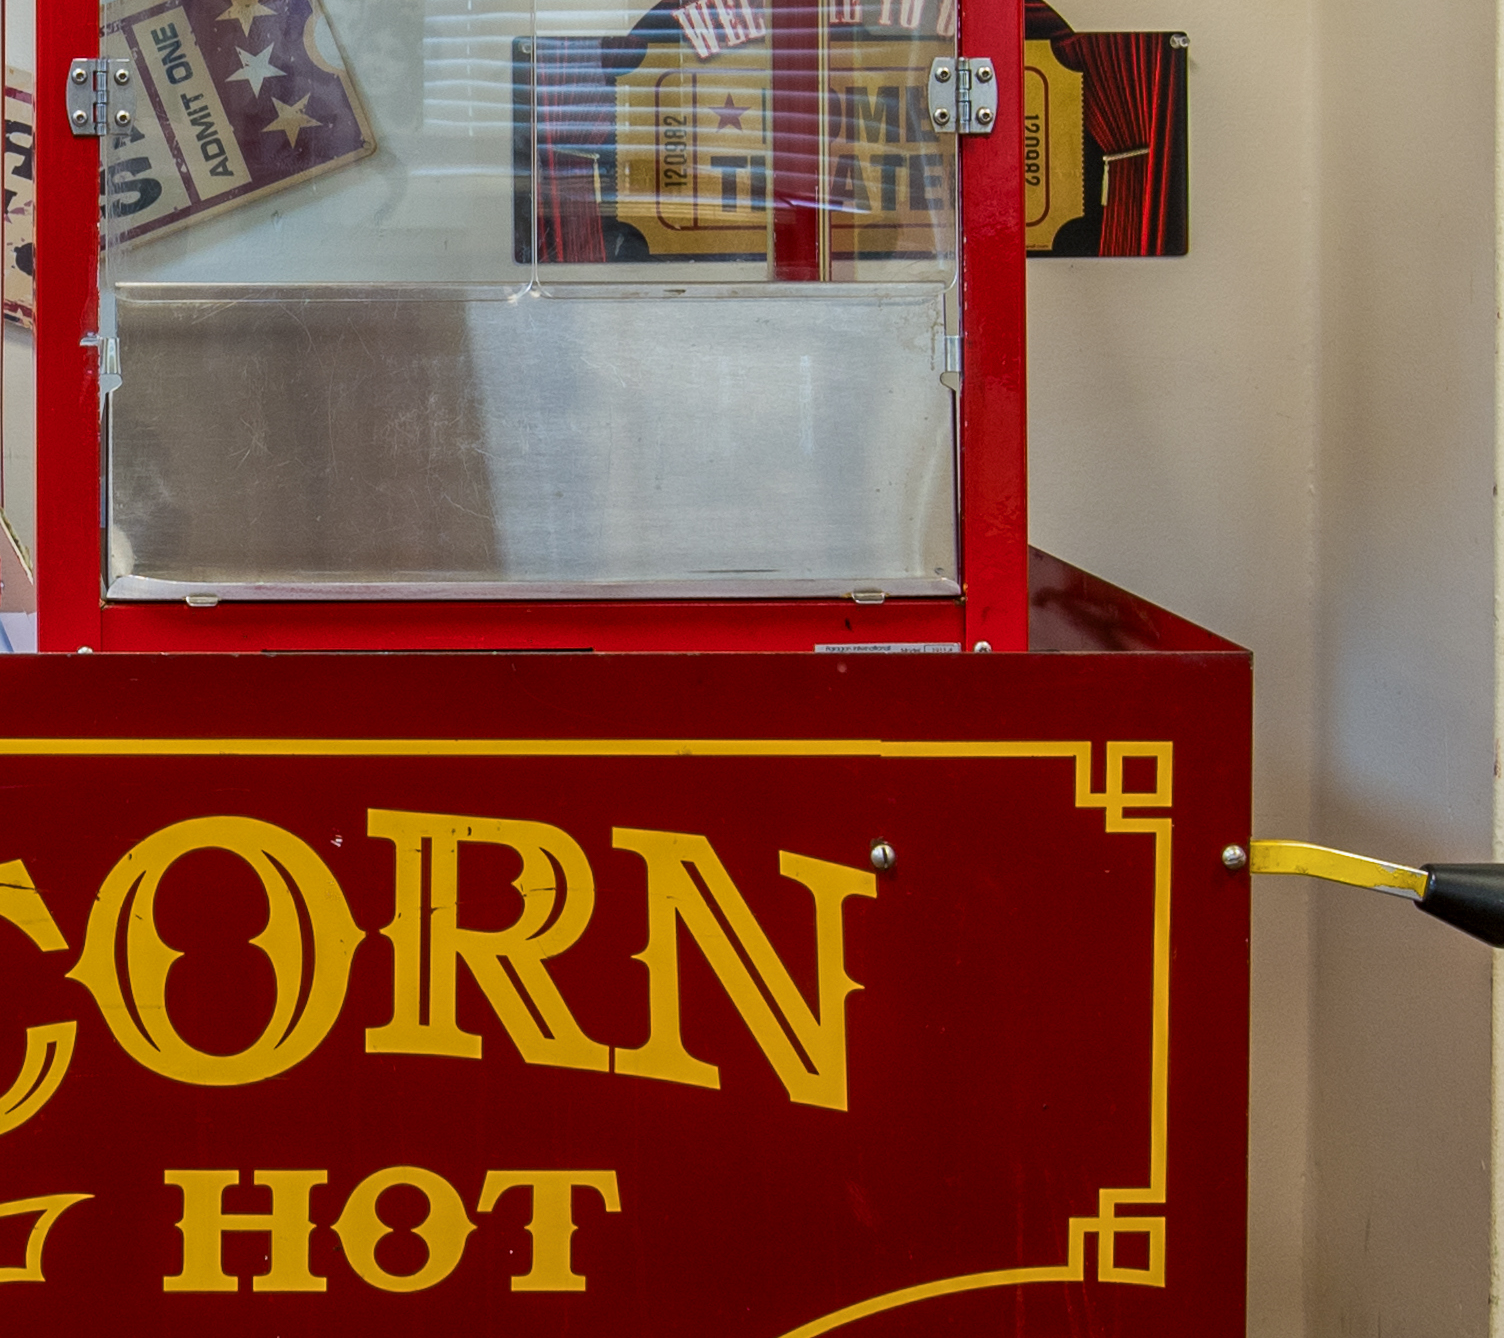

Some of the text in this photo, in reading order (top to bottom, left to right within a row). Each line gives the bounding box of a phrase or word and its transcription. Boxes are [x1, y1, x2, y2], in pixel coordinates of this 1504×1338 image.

[150, 22, 194, 86] ONE
[180, 92, 235, 178] ADMIT
[662, 115, 688, 190] 120982
[1024, 113, 1041, 188] 120982
[162, 1164, 622, 1293] HOT
